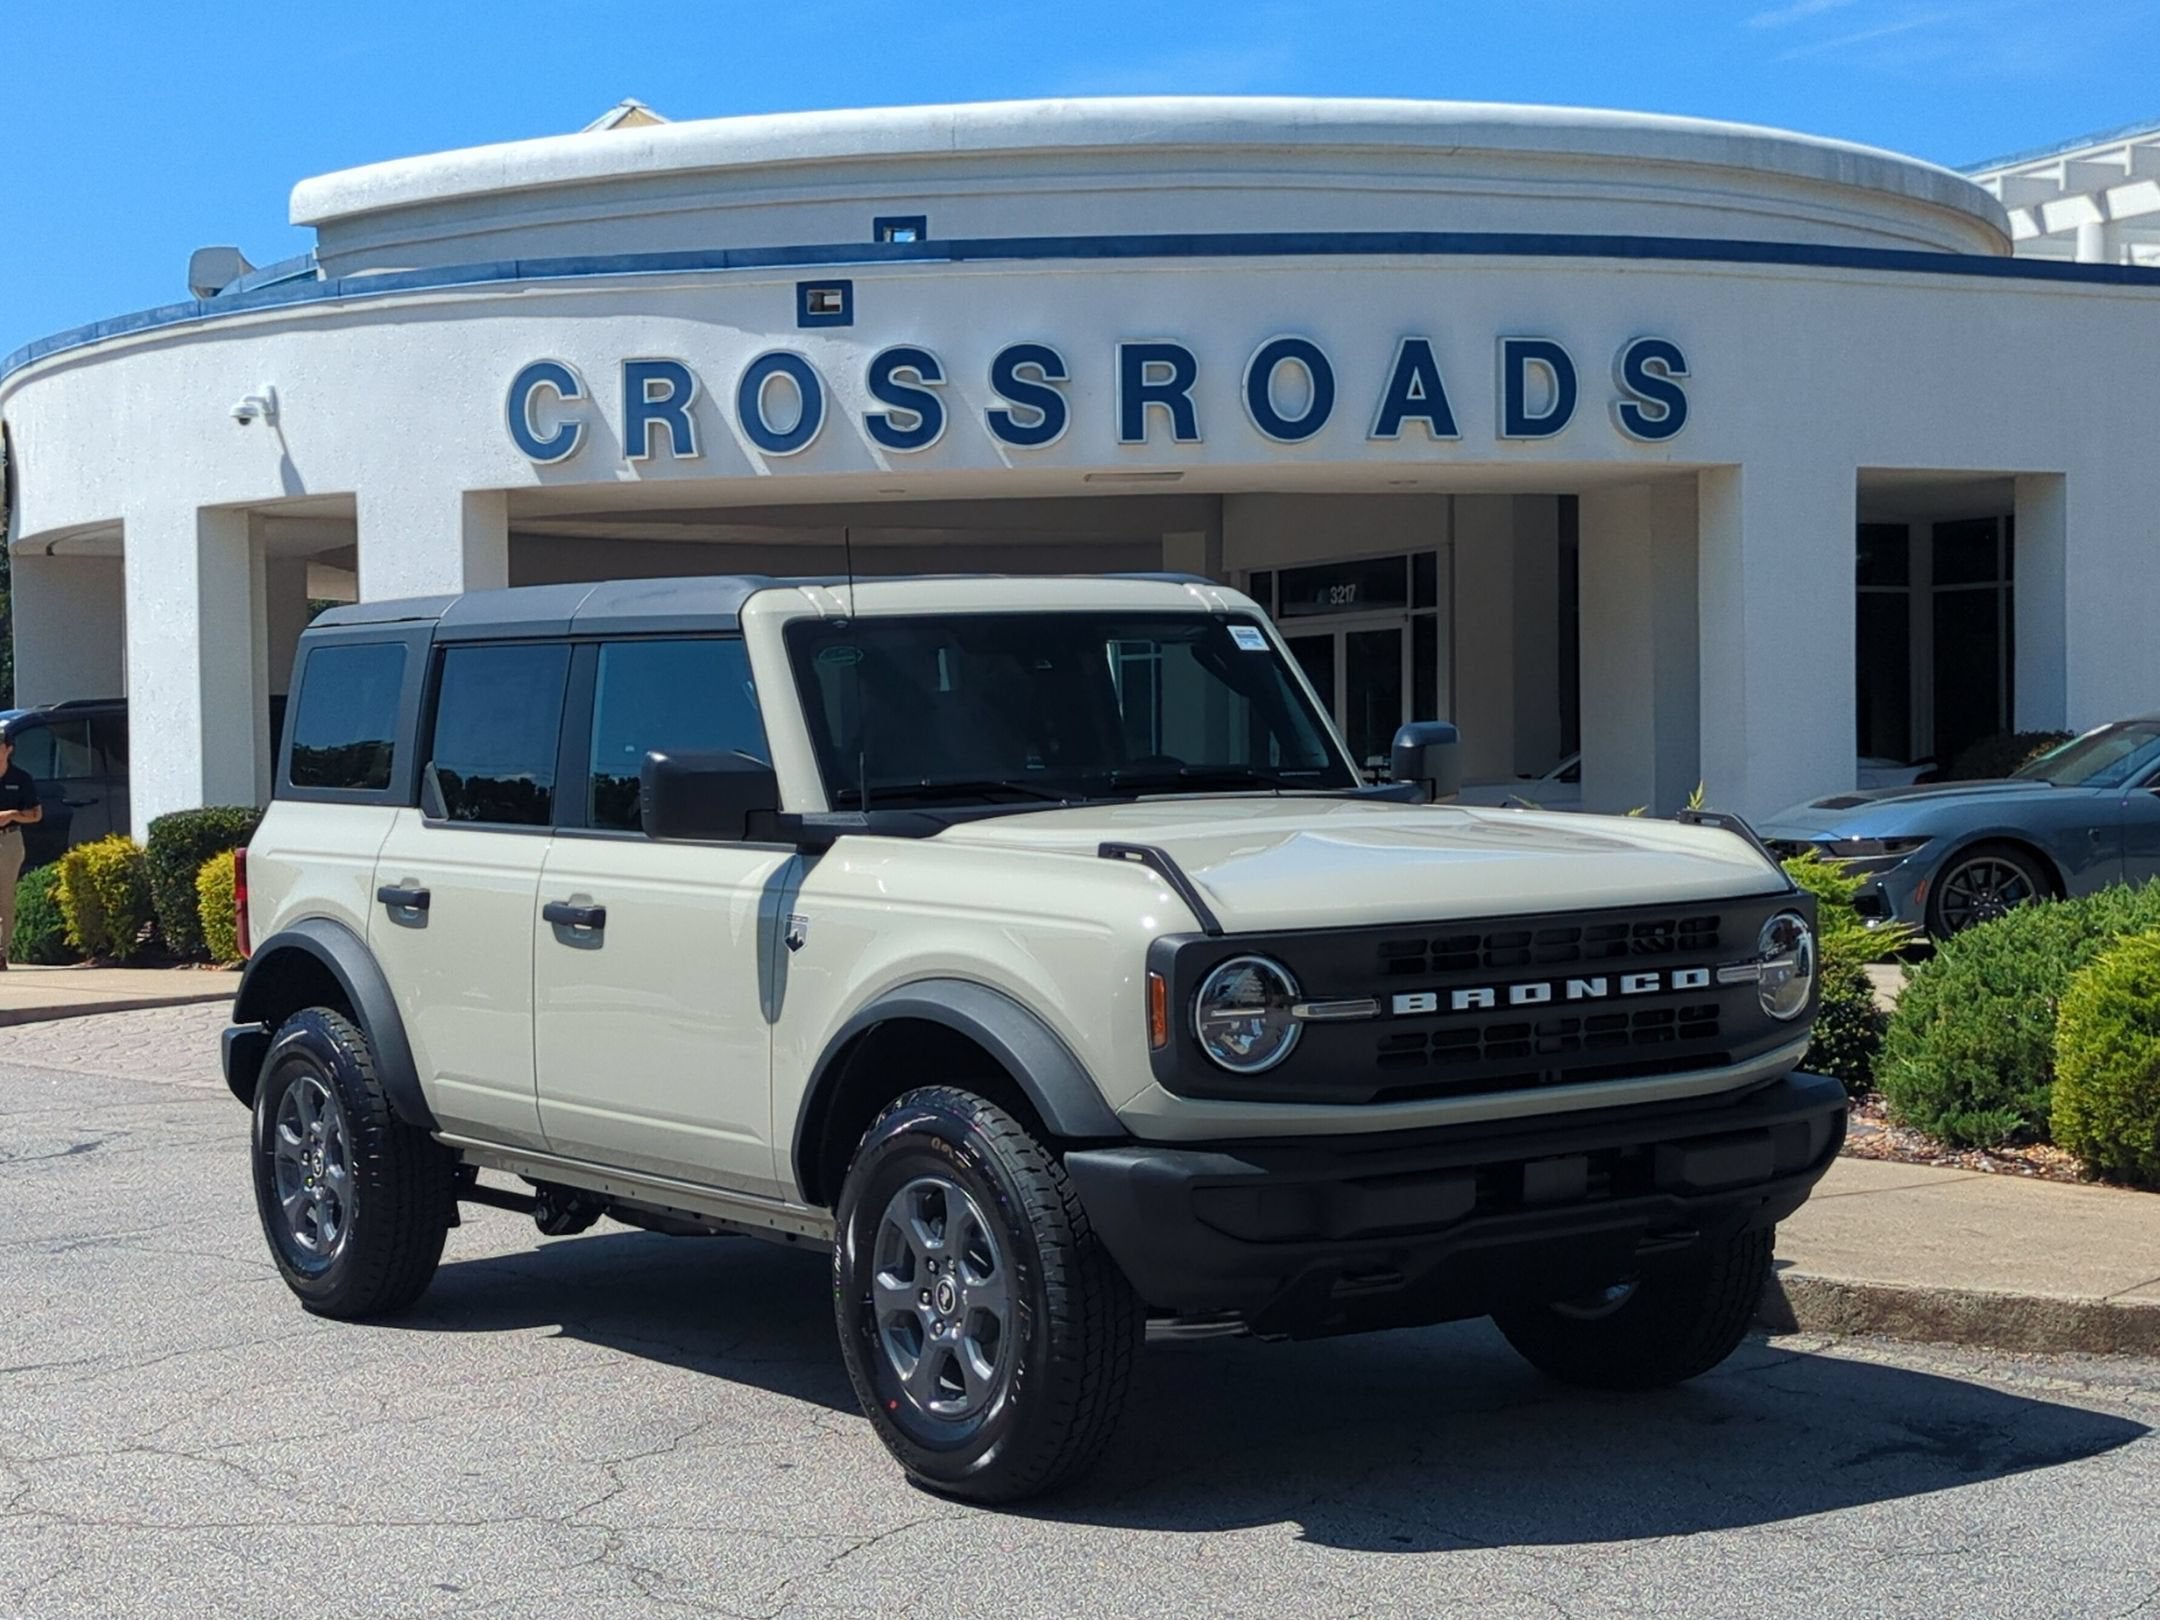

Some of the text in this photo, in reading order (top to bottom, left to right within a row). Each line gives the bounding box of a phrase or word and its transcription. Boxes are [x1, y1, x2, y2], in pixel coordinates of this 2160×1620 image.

[507, 334, 1691, 465] CROSSROADS
[1330, 584, 1356, 604] 3217
[1392, 968, 1710, 1015] BRONCO
